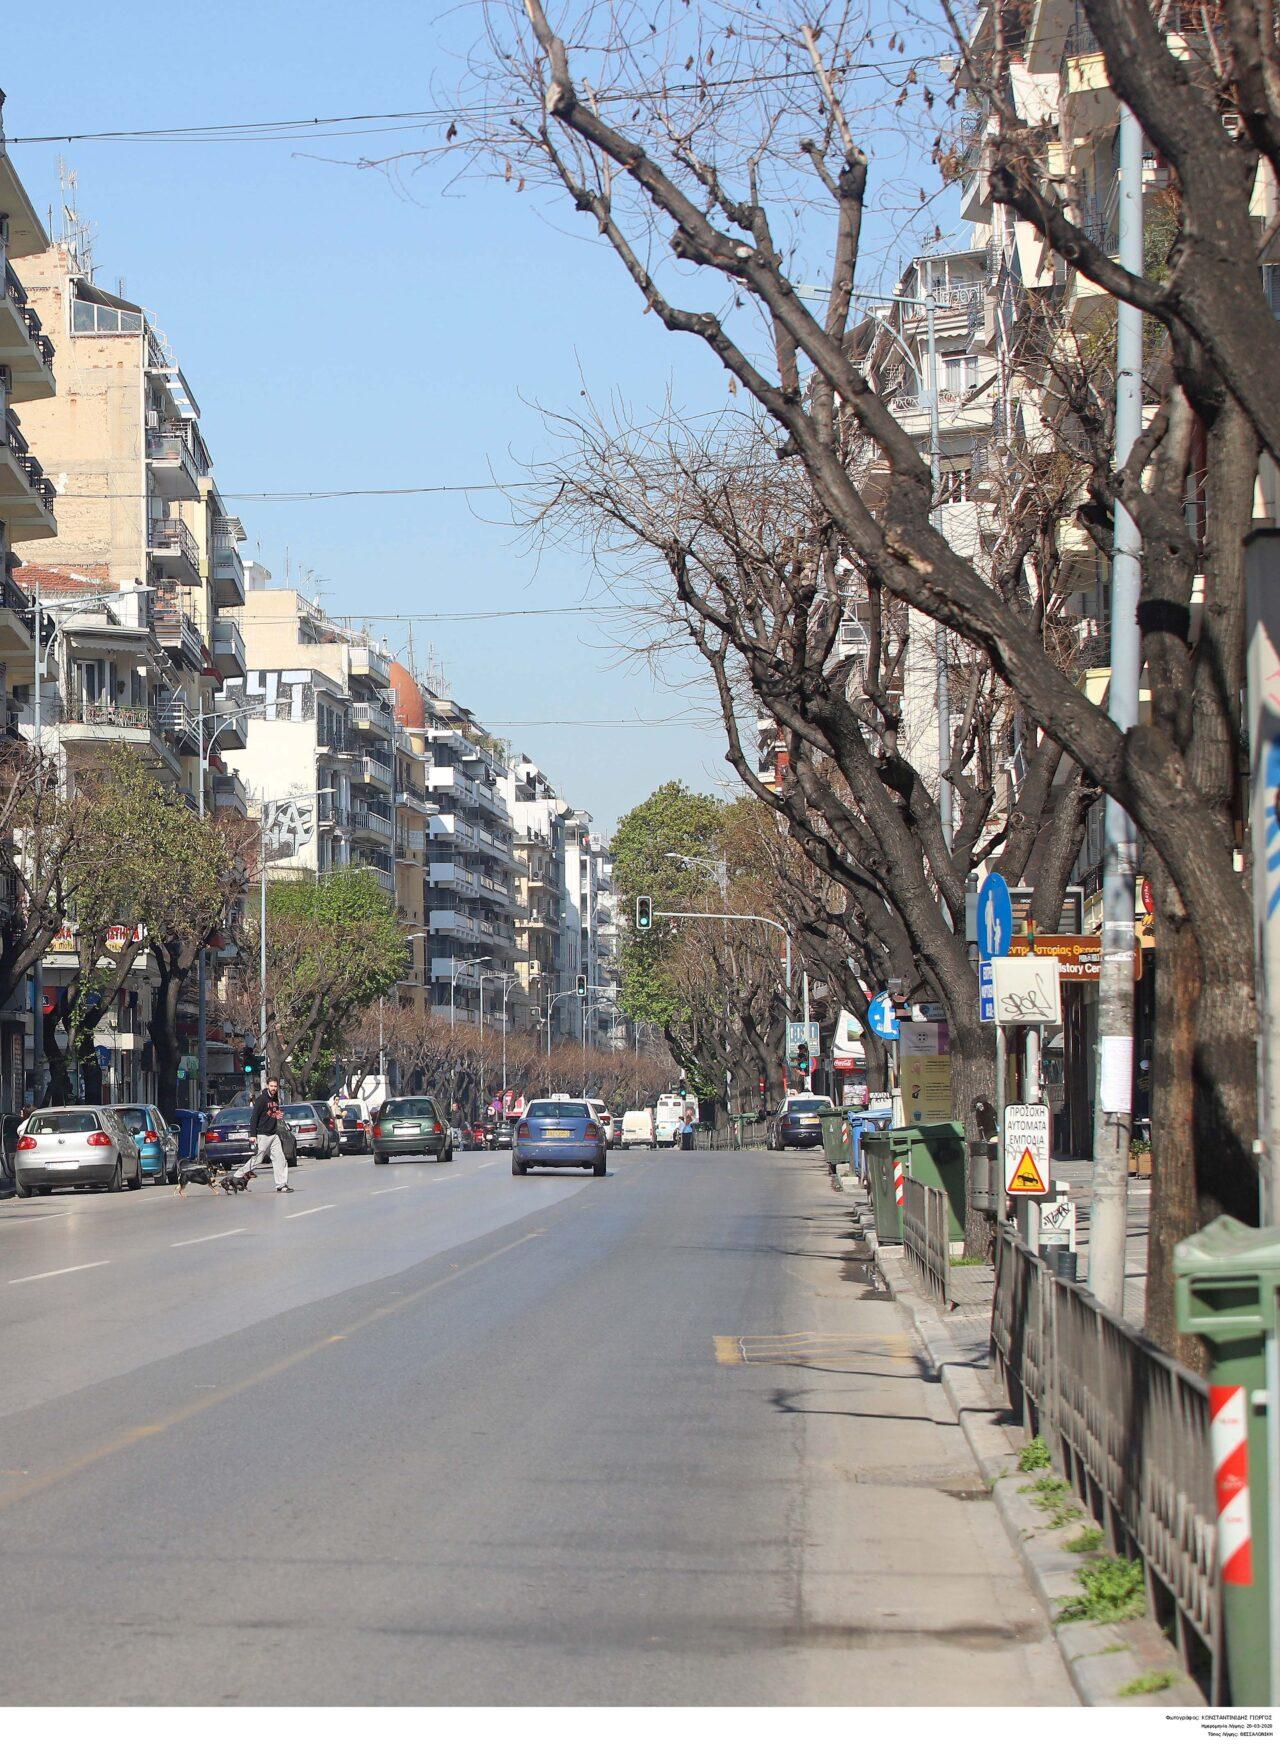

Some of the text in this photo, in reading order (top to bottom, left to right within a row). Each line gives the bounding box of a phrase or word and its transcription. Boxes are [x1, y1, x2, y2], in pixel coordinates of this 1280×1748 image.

[1009, 1107, 1045, 1118] ΠΡΟΣΟΧΗ
[1007, 1120, 1047, 1131] ΑΥΤΟΜΑΤΑ
[1009, 1135, 1045, 1145] ΕΜΠΟΔΙΑ
